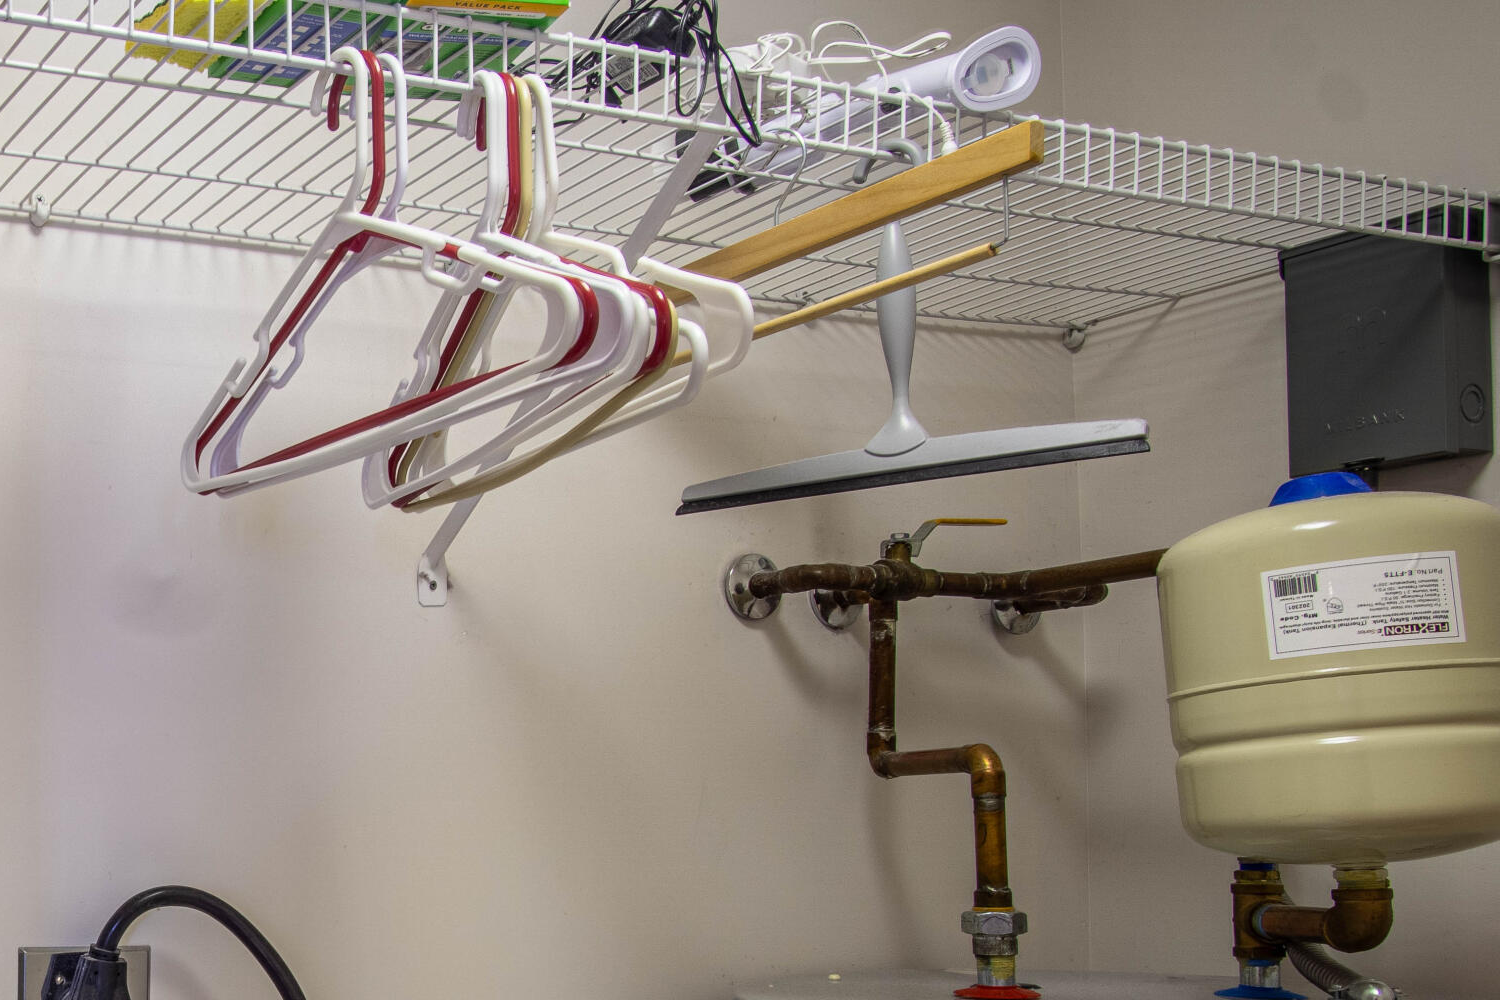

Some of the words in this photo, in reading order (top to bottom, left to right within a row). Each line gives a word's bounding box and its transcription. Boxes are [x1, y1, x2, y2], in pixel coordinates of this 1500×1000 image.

[455, 1, 489, 9] VALUE
[1428, 567, 1442, 575] Part
[1389, 615, 1409, 623] Safety
[1383, 619, 1449, 637] FLEXTRON
